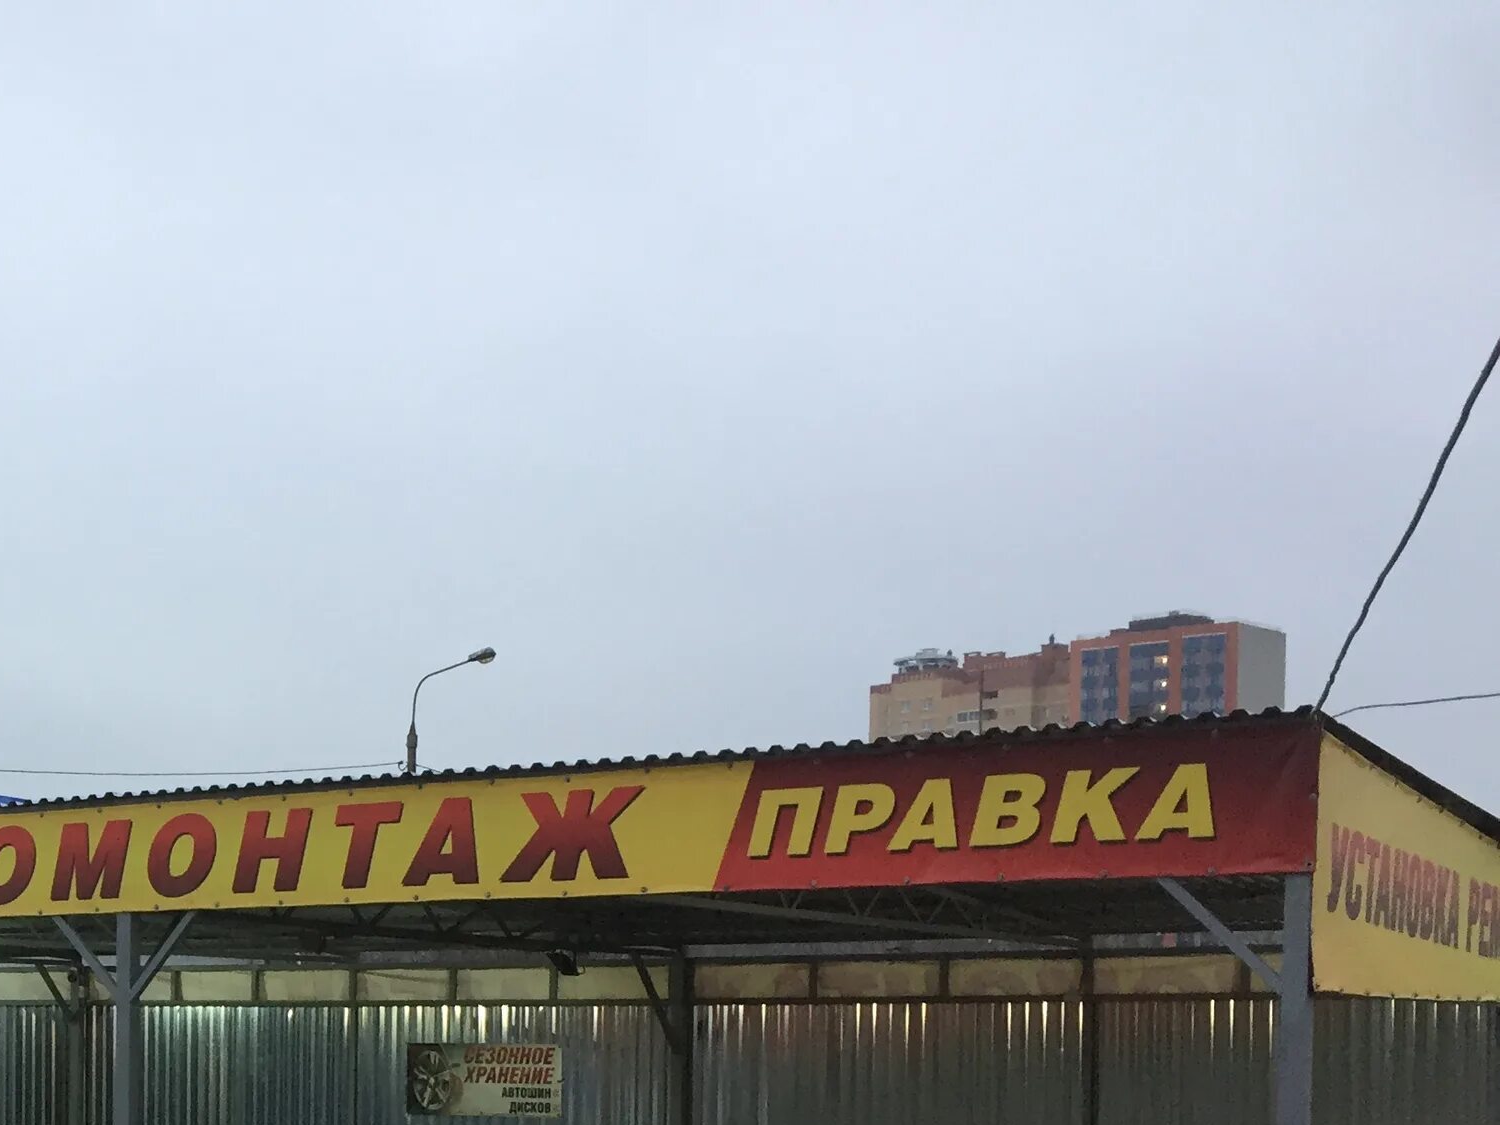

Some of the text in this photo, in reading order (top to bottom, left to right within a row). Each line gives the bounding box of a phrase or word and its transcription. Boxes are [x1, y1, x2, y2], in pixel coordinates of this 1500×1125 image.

[746, 762, 1217, 859] ПРАВКА
[1326, 821, 1461, 950] УСТАНОВКА
[463, 1047, 556, 1065] СЕЗОННОЕ
[463, 1066, 555, 1085] ХРАНЕНИЕ
[501, 1087, 552, 1099] АВТОШИН
[509, 1102, 552, 1114] ДИСКОВ
